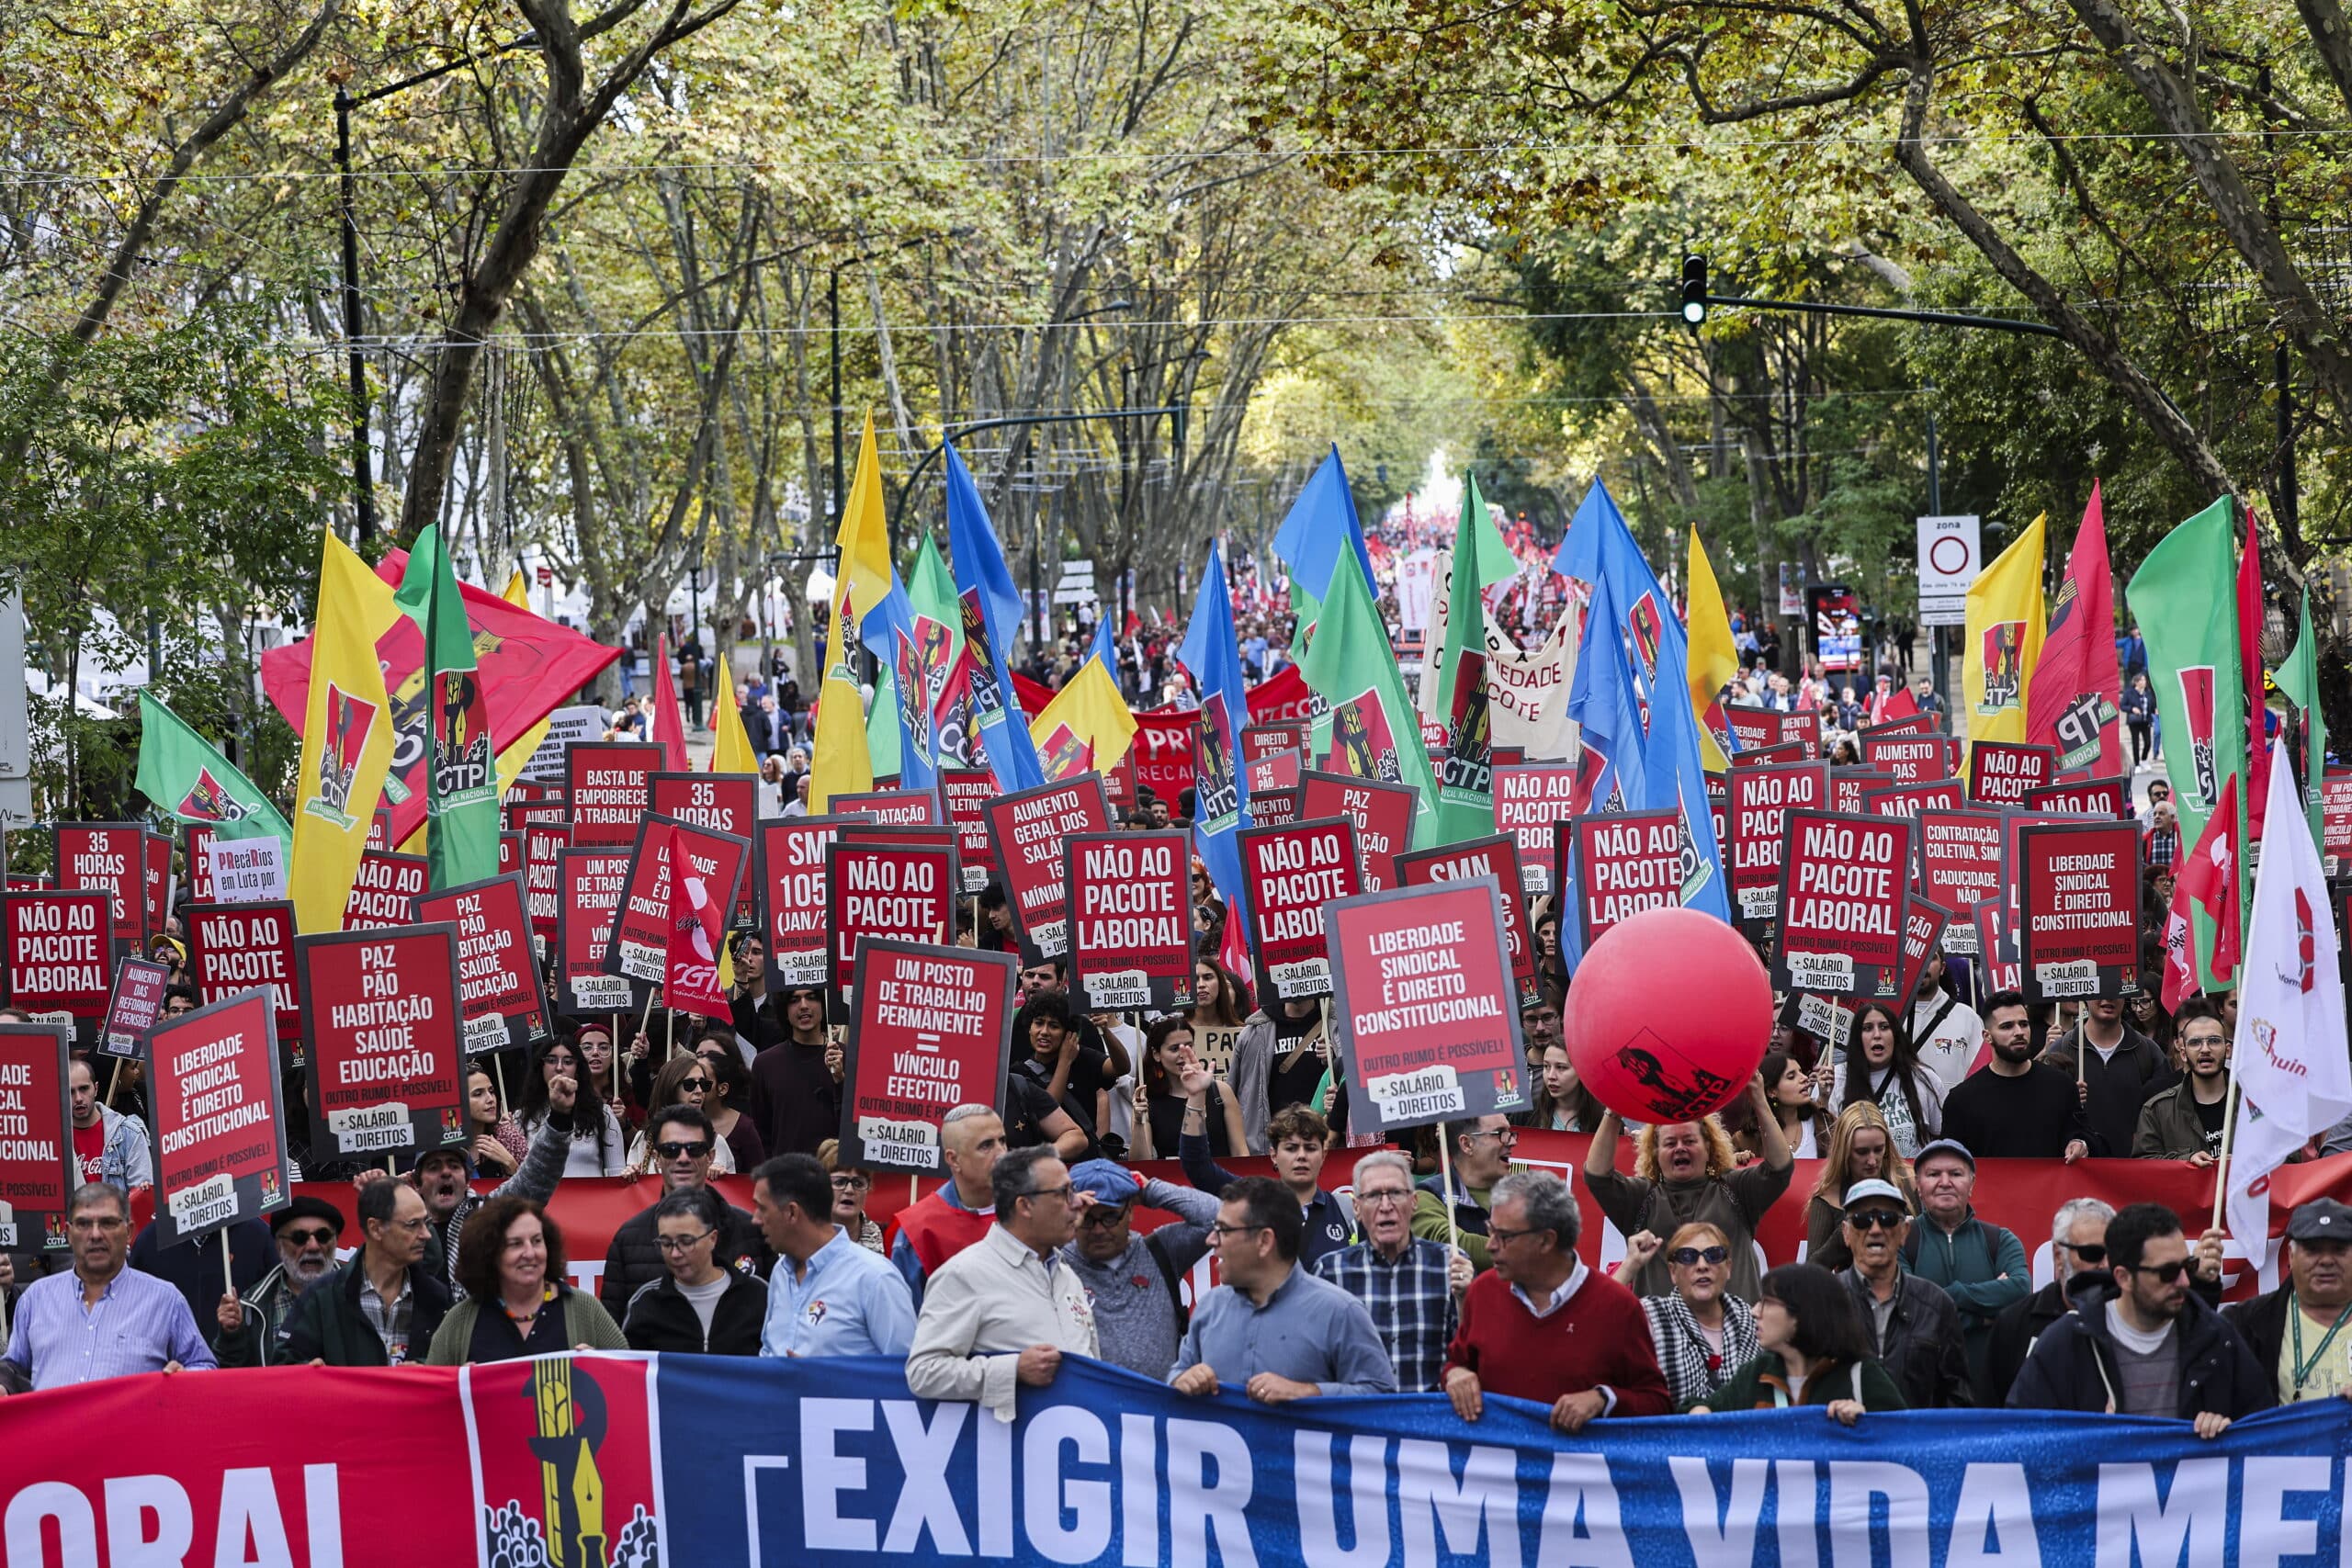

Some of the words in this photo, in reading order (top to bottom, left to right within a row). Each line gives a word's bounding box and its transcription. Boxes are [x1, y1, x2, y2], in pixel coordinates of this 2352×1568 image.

[1937, 521, 1961, 529] zona
[1254, 733, 1287, 747] DIREITO
[1875, 743, 1933, 761] AUMENTO
[1984, 751, 2017, 774] NÃO
[2019, 756, 2041, 776] AO
[587, 771, 626, 785] BASTA
[629, 770, 645, 785] DE
[1256, 763, 1272, 778] PAZ
[1893, 763, 1917, 778] DAS
[575, 788, 648, 805] EMPOBRECE
[691, 784, 714, 807] 35
[1504, 773, 1541, 798] NÃO
[1546, 776, 1570, 796] AO
[1743, 775, 1781, 807] NÃO
[1787, 776, 1813, 803] AO
[1839, 783, 1860, 797] PAZ
[1013, 791, 1080, 824] AUMENTO
[1343, 789, 1370, 809] PAZ
[1839, 797, 1860, 813] PÃO
[2085, 793, 2111, 814] AO
[574, 809, 582, 823] A
[673, 807, 733, 831] HORAS
[1501, 801, 1571, 824] PACOTE
[1014, 818, 1060, 845] GERAL
[1062, 809, 1089, 834] DOS
[1928, 826, 2000, 845] CONTRATAÇÃO
[89, 832, 108, 852] 35
[1594, 823, 1641, 857] NÃO
[1648, 824, 1678, 852] AO
[1804, 823, 1854, 861] NÃO
[1860, 832, 1893, 863] AO
[74, 852, 125, 875] HORAS
[218, 848, 274, 871] PRecáRios
[1085, 843, 1133, 880] NÃO
[1140, 847, 1171, 878] AO
[1258, 837, 1305, 873] NÃO
[1310, 834, 1340, 866] AO
[1927, 843, 1978, 863] COLETIVA,
[1981, 847, 2000, 861] SIM!
[2049, 853, 2116, 873] LIBERDADE
[221, 875, 235, 891] em
[237, 872, 258, 888] Luta
[261, 872, 275, 890] por
[353, 860, 391, 888] NÃO
[396, 867, 423, 893] AO
[848, 855, 895, 893] NÃO
[902, 863, 934, 893] AO
[1595, 857, 1681, 891] PACOTE
[1799, 862, 1894, 899] PACOTE
[1933, 870, 2000, 890] CADUCIDADE,
[2054, 874, 2110, 892] SINDICAL
[81, 876, 119, 897] PARA
[1261, 868, 1348, 908] PACOTE
[1957, 887, 1981, 903] NÃO!
[457, 895, 482, 916] PAZ
[1085, 882, 1175, 915] PACOTE
[2054, 892, 2062, 911] É
[2065, 892, 2111, 910] DIREITO
[17, 900, 61, 931] NÃO
[68, 905, 95, 931] AO
[847, 895, 936, 929] PACOTE
[1788, 897, 1897, 936] LABORAL
[2032, 911, 2133, 932] CONSTITUCIONAL
[202, 916, 245, 949] NÃO
[252, 918, 280, 947] AO
[460, 913, 485, 936] PÃO
[1078, 917, 1186, 951] LABORAL
[1947, 928, 1974, 940] SALÁRIO
[18, 933, 98, 964] PACOTE
[1369, 920, 1465, 956] LIBERDADE
[205, 951, 287, 982] PACOTE
[361, 945, 396, 970] PAZ
[460, 953, 503, 980] SAÚDE
[1380, 949, 1462, 979] SINDICAL
[1804, 957, 1843, 973] SALÁRIO
[11, 965, 107, 994] LABORAL
[128, 967, 161, 986] AUMENTO
[895, 958, 921, 981] UM
[923, 963, 974, 987] POSTO
[1099, 976, 1138, 991] SALÁRIO
[1284, 964, 1321, 980] SALÁRIO
[1806, 973, 1849, 988] DIREITOS
[2051, 966, 2088, 980] SALÁRIO
[133, 984, 148, 998] DAS
[363, 971, 398, 998] PÃO
[1291, 977, 1329, 995] DIREITOS
[1383, 978, 1394, 1005] É
[1397, 973, 1465, 1002] DIREITO
[2055, 980, 2095, 994] DIREITOS
[118, 995, 156, 1014] REFORMAS
[879, 981, 899, 1003] DE
[904, 984, 986, 1012] TRABALHO
[1104, 991, 1146, 1006] DIREITOS
[1175, 995, 1191, 1003] CGTP
[1524, 995, 1540, 1004] CGTP
[115, 1010, 120, 1022] E
[121, 1011, 152, 1030] PENSÕES
[332, 994, 433, 1029] HABITAÇÃO
[877, 1004, 984, 1036] PERMANENTE
[1354, 994, 1502, 1036] CONSTITUCIONAL
[355, 1023, 415, 1055] SAÚDE
[173, 1032, 244, 1077] LIBERDADE
[893, 1050, 960, 1080] VÍNCULO
[1363, 1054, 1399, 1072] OUTRO
[1403, 1048, 1435, 1066] RUMO
[1438, 1043, 1445, 1062] É
[1448, 1039, 1504, 1059] POSSÍVEL!
[181, 1060, 240, 1098] SINDICAL
[339, 1051, 435, 1085] EDUCAÇÃO
[326, 1089, 359, 1104] OUTRO
[362, 1085, 390, 1100] RUMO
[402, 1078, 452, 1096] POSSÍVEL!
[887, 1076, 961, 1104] EFECTIVO
[1390, 1073, 1444, 1095] SALÁRIO
[182, 1100, 190, 1122] É
[193, 1083, 243, 1121] DIREITO
[860, 1096, 891, 1113] OUTRO
[894, 1100, 922, 1116] RUMO
[1398, 1093, 1456, 1115] DIREITOS
[1496, 1092, 1521, 1103] CGTP
[162, 1100, 270, 1155] CONSTITUCIONAL
[349, 1110, 397, 1129] SALÁRIO
[356, 1128, 407, 1147] DIREITOS
[444, 1130, 463, 1140] CGTP
[877, 1123, 925, 1145] SALÁRIO
[166, 1168, 192, 1188] OUTRO
[194, 1157, 219, 1179] RUMO
[227, 1143, 271, 1169] POSSÍVEL!
[880, 1144, 933, 1165] DIREITOS
[6, 1181, 58, 1197] POSSÍVEL!
[184, 1183, 223, 1210] SALÁRIO
[262, 1191, 281, 1205] CGTP
[189, 1199, 232, 1227] DIREITOS
[47, 1237, 66, 1247] CGTP
[800, 1396, 1260, 1568] EXIGIR
[1294, 1429, 1634, 1568] UMA
[1668, 1453, 2045, 1568] VIDA
